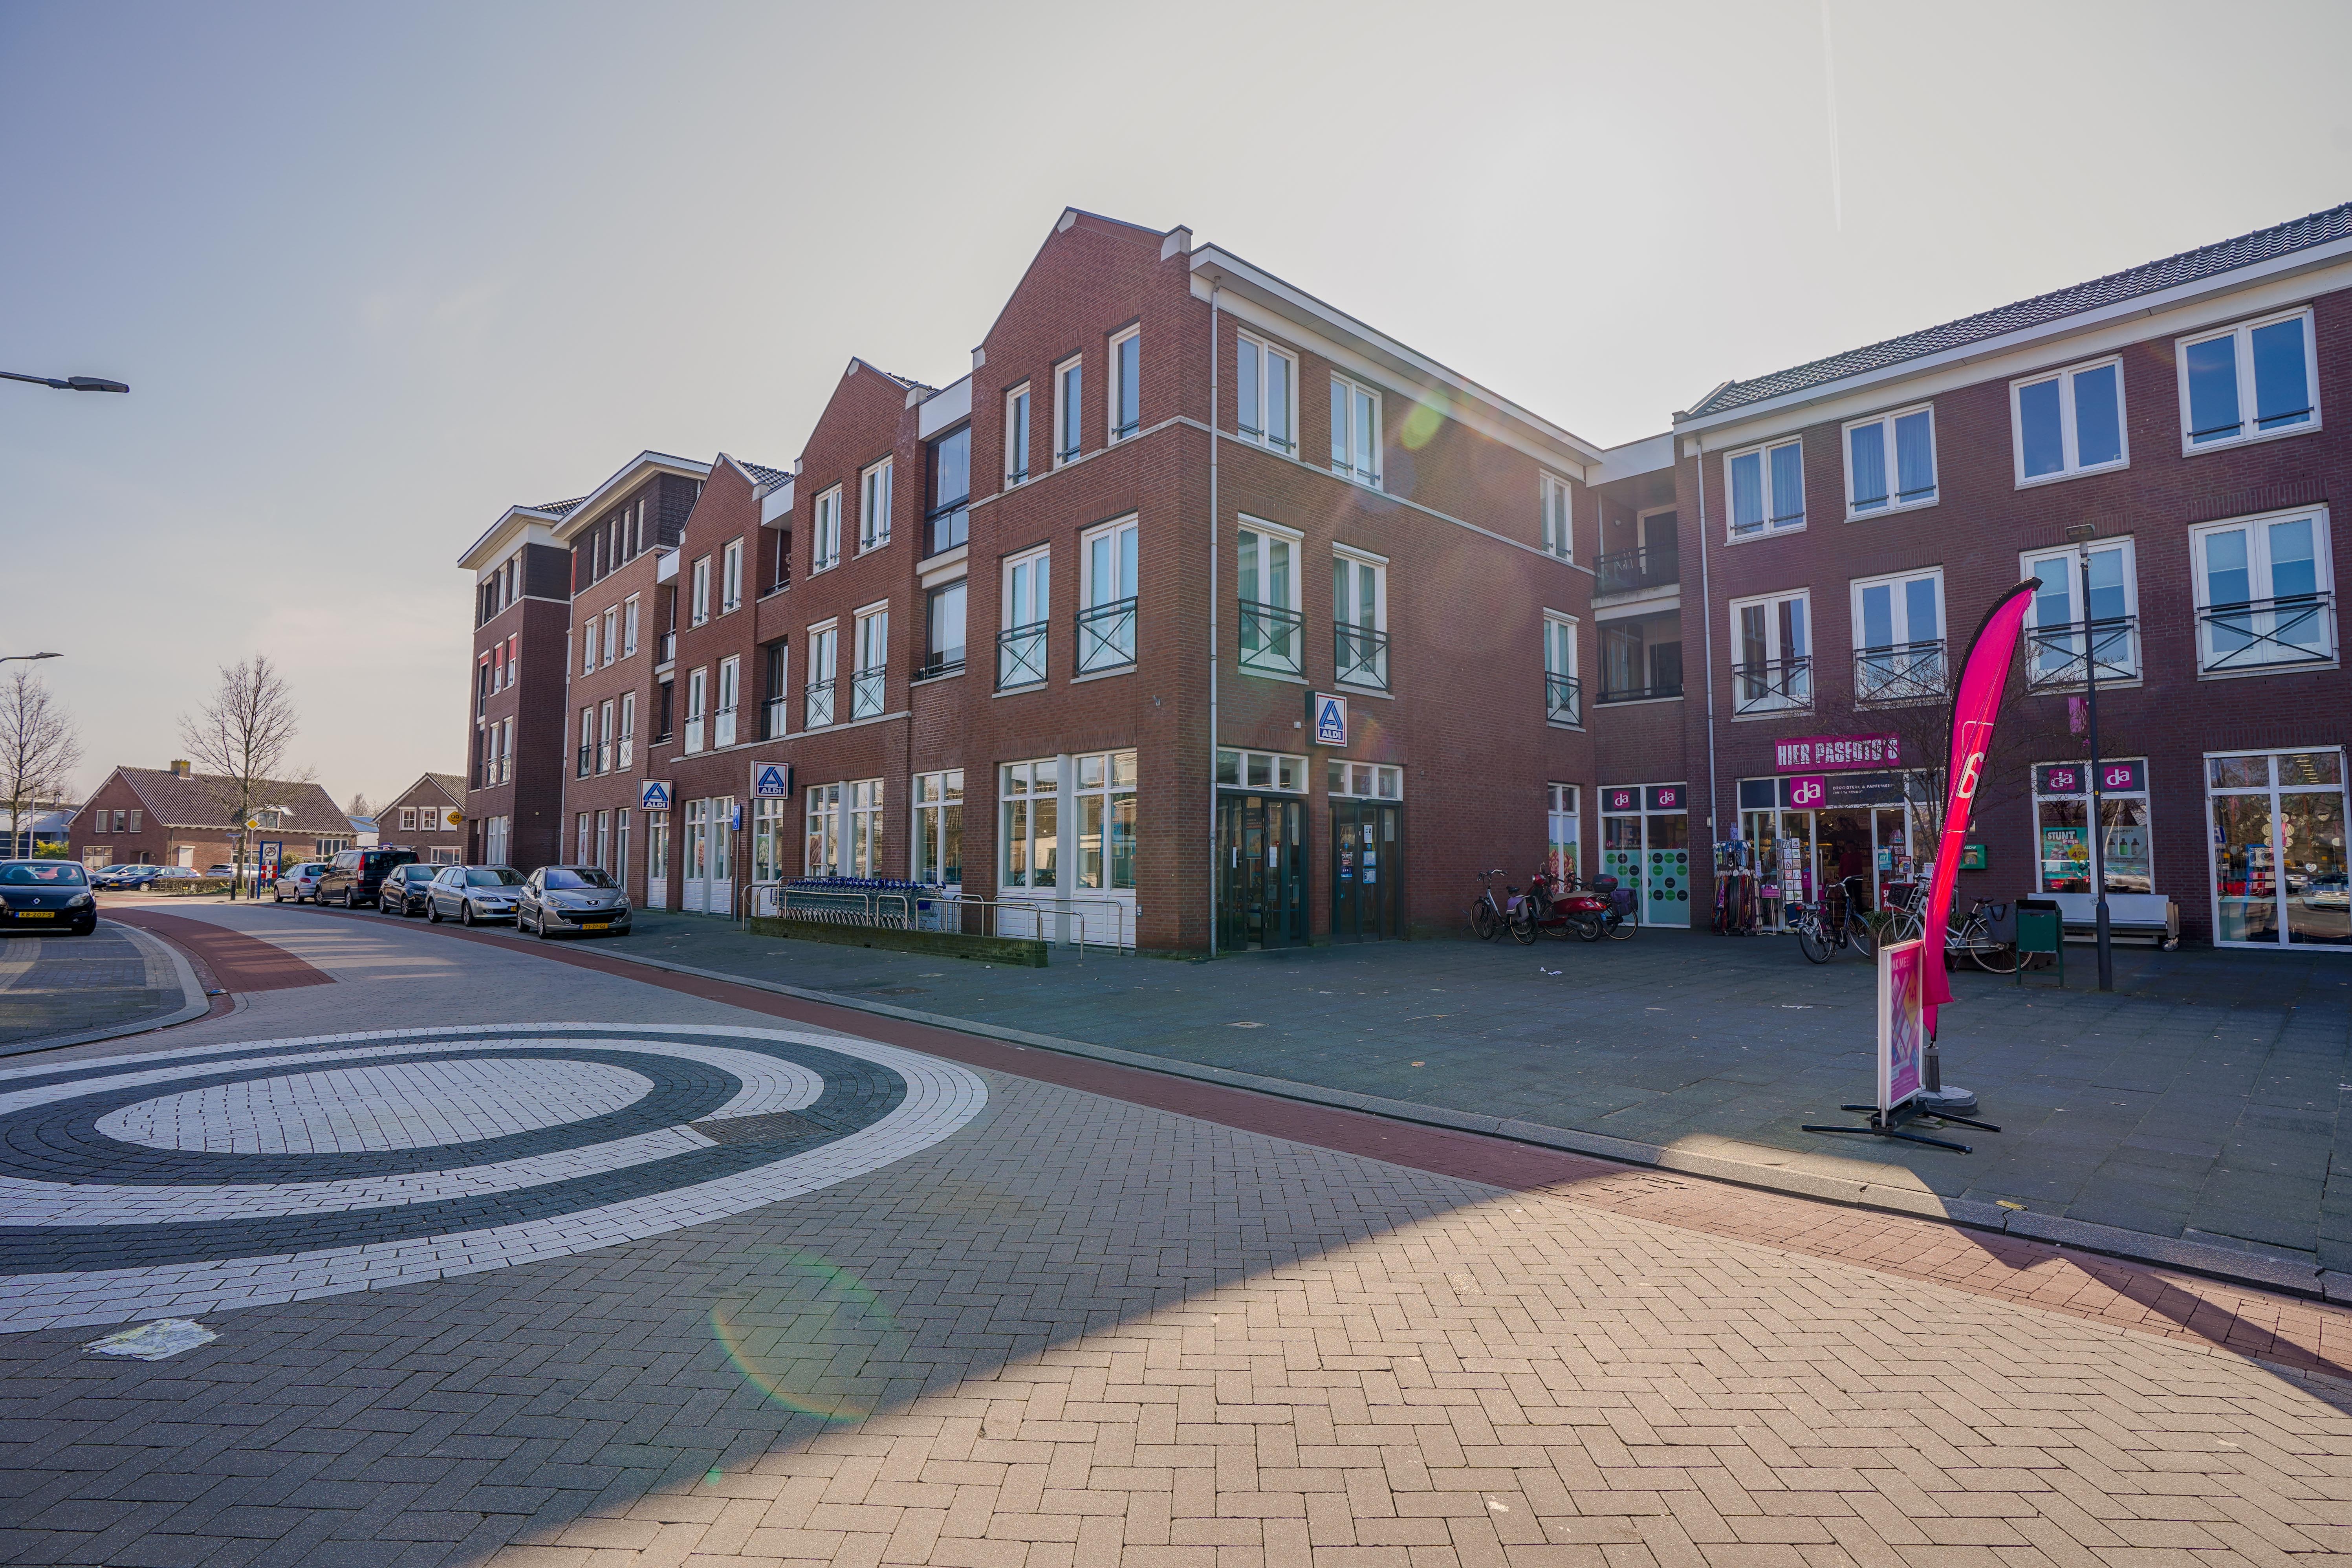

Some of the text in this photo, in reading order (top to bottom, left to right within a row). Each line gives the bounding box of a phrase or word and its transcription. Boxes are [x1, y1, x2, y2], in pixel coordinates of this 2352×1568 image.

[1321, 729, 1341, 739] ALDI
[1777, 744, 1810, 766] HIER
[2051, 771, 2073, 788] da
[2106, 769, 2130, 785] da
[1660, 791, 1674, 804] da
[1793, 781, 1821, 804] da
[1614, 793, 1628, 806] da
[734, 808, 738, 820] P
[2048, 831, 2075, 840] STUNT
